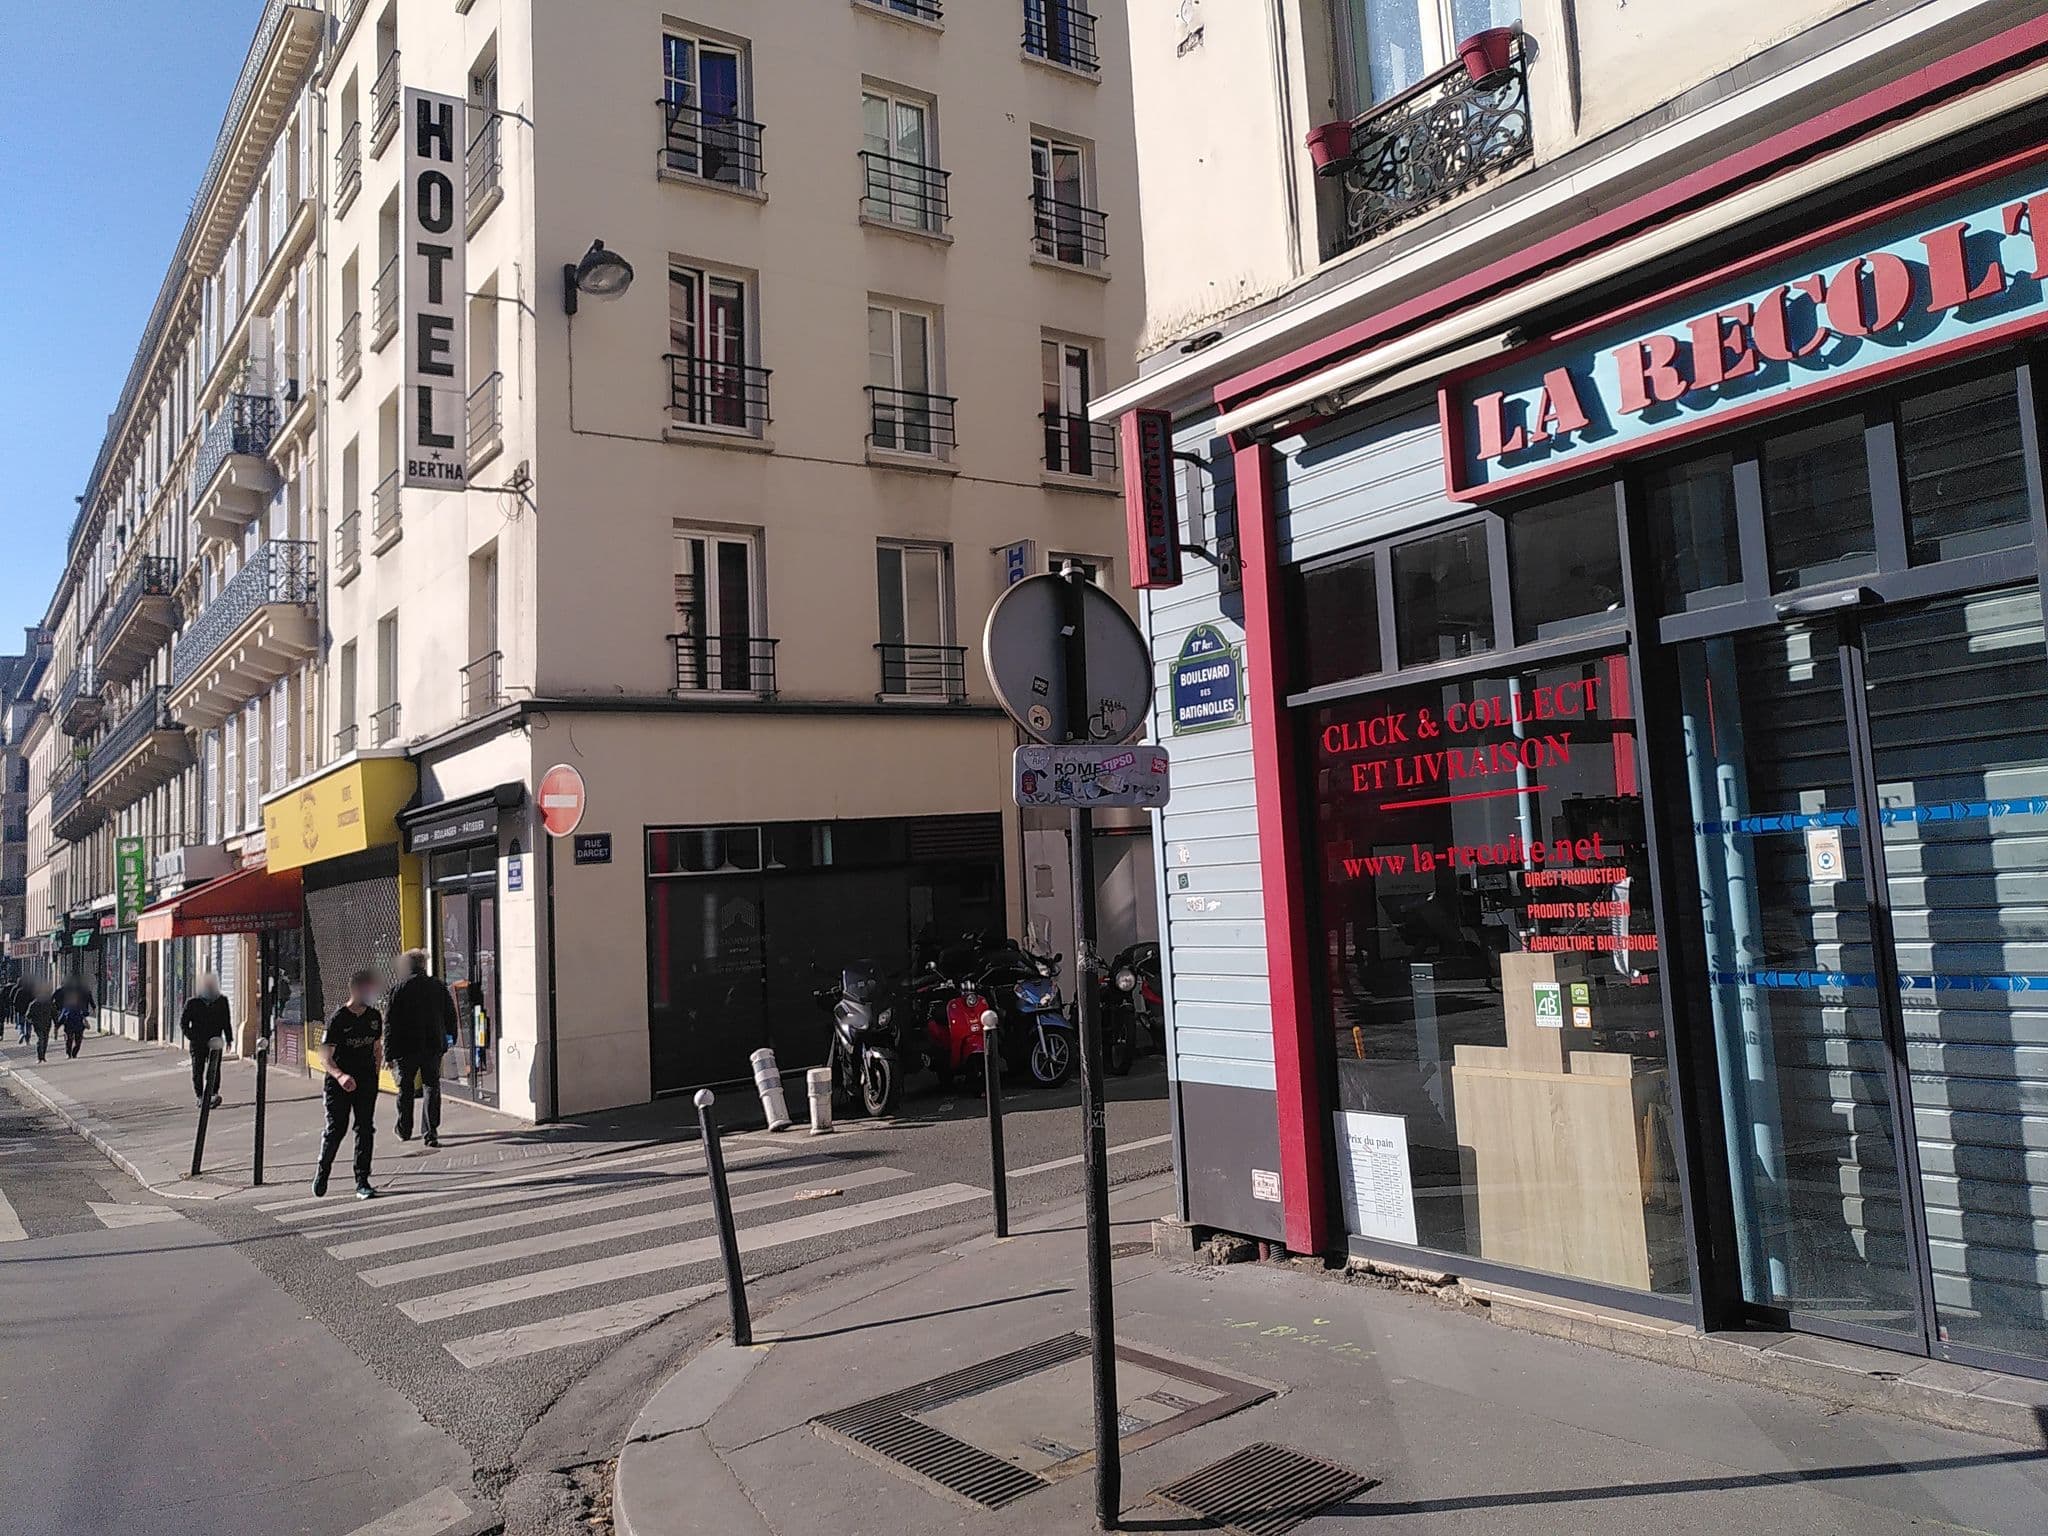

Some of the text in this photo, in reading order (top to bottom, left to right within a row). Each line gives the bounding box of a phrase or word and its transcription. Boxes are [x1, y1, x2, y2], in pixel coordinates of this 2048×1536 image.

[417, 99, 454, 448] HOTEL
[1473, 366, 1591, 461] LA
[408, 459, 464, 480] BERTHA
[1180, 664, 1230, 686] BOULEVARD
[1200, 688, 1211, 697] DES
[1179, 698, 1235, 720] BATIGNOLLES
[1322, 678, 1601, 753] CLICK & COLLECT
[1352, 732, 1571, 792] ET LIVRAISON
[577, 848, 609, 857] DARCET
[584, 839, 602, 848] RUE
[121, 841, 139, 924] PIZZA
[1525, 867, 1627, 887] DIRECT PRODUCTEUR
[1527, 903, 1575, 918] PRODUITS
[1577, 902, 1590, 917] DE
[1530, 934, 1595, 951] AGRICULTURE
[1538, 996, 1558, 1015] AB
[1364, 1135, 1374, 1146] du
[1376, 1138, 1394, 1149] pain
